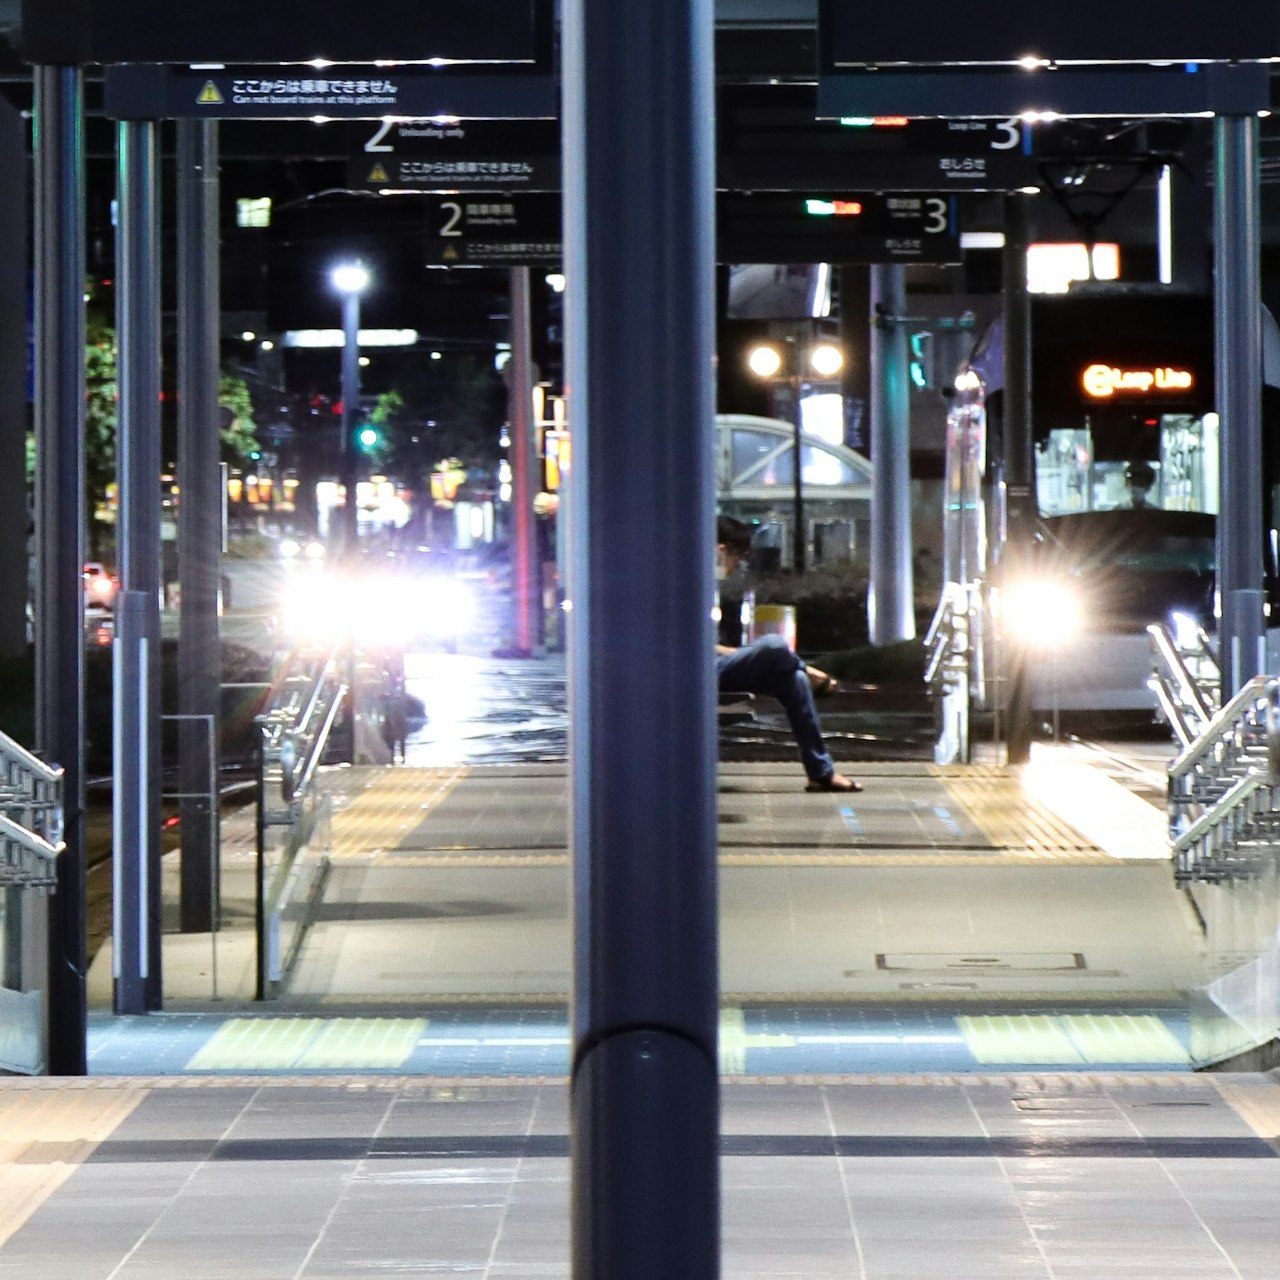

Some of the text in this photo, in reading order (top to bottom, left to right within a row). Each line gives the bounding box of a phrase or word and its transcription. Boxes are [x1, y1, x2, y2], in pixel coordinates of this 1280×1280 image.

[990, 118, 1020, 150] 3
[439, 202, 463, 237] 2
[924, 198, 947, 233] 3
